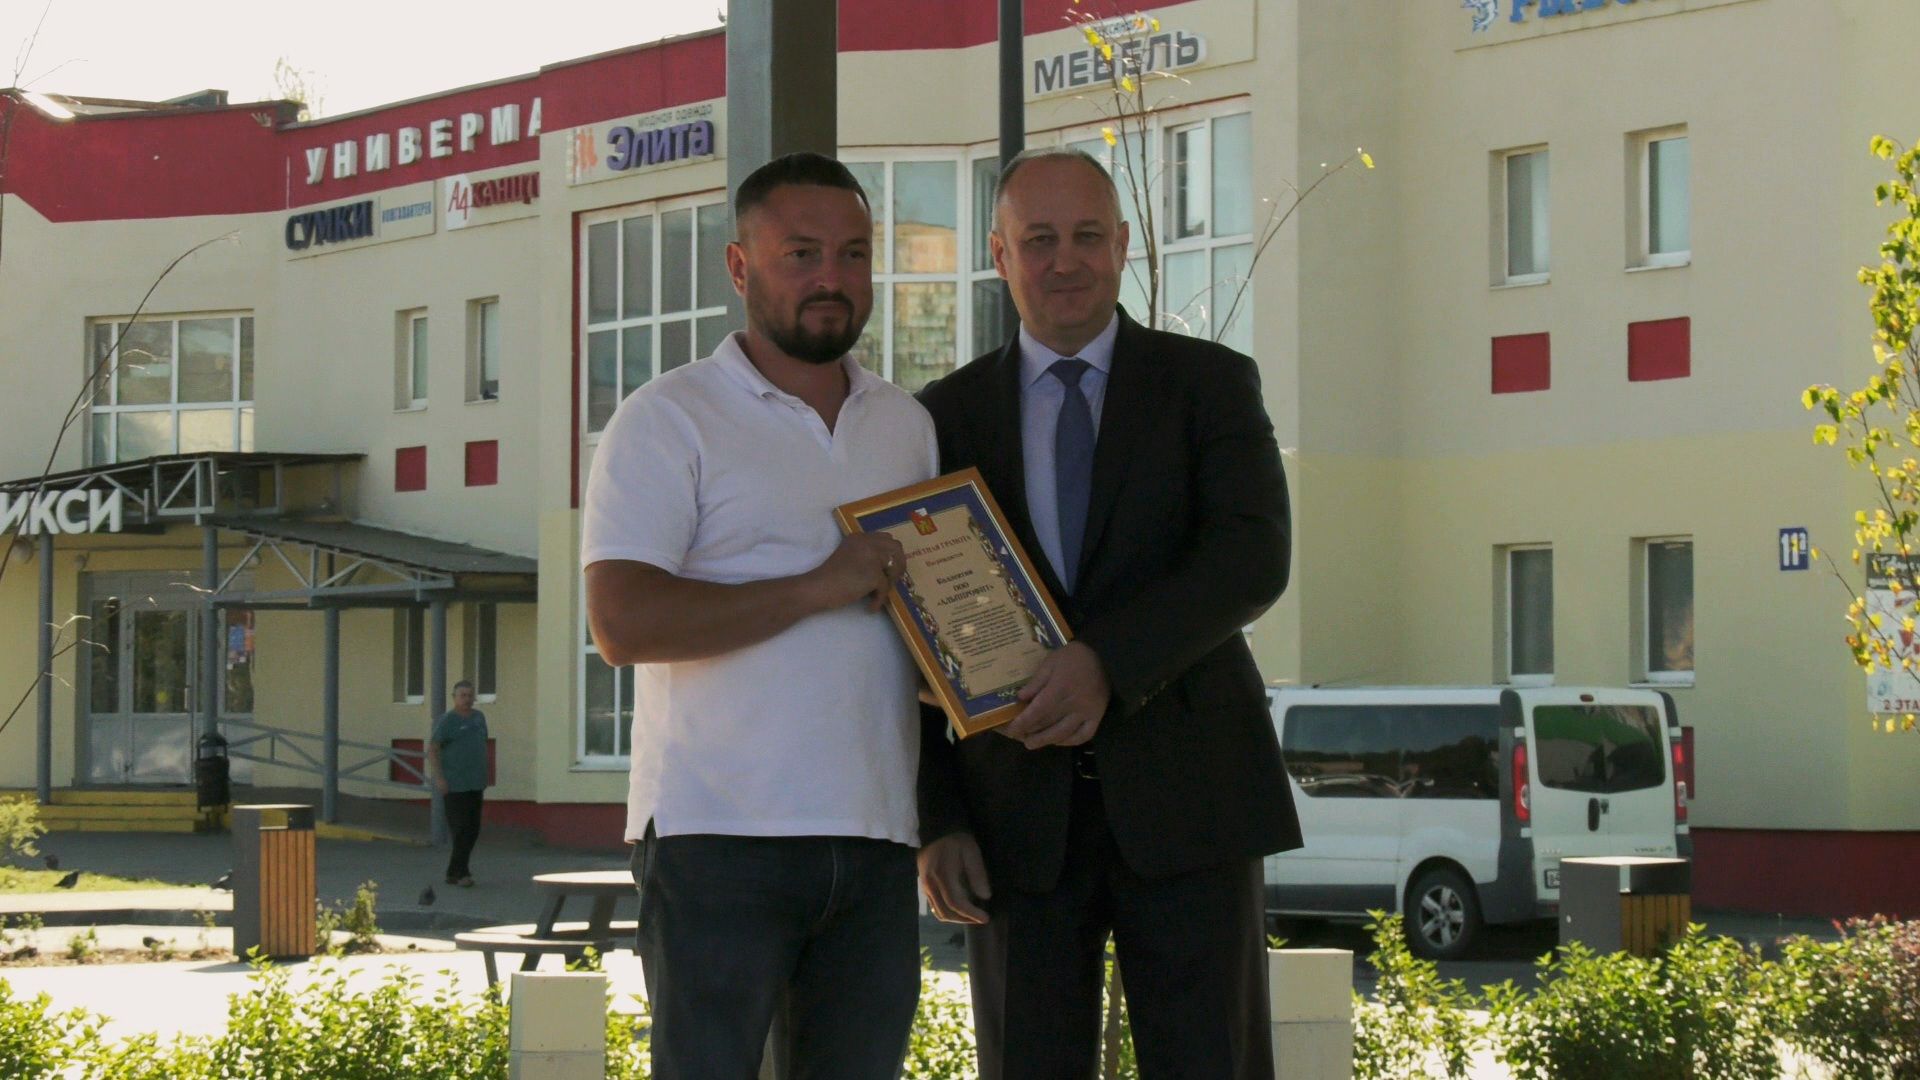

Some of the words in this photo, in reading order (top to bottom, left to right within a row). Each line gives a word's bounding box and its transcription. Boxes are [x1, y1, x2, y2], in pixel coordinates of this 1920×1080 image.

[1034, 31, 1199, 94] МЕБЕЛЬ
[606, 119, 714, 171] Элита
[285, 199, 373, 251] СУМКИ
[0, 488, 123, 535] ИКСИ
